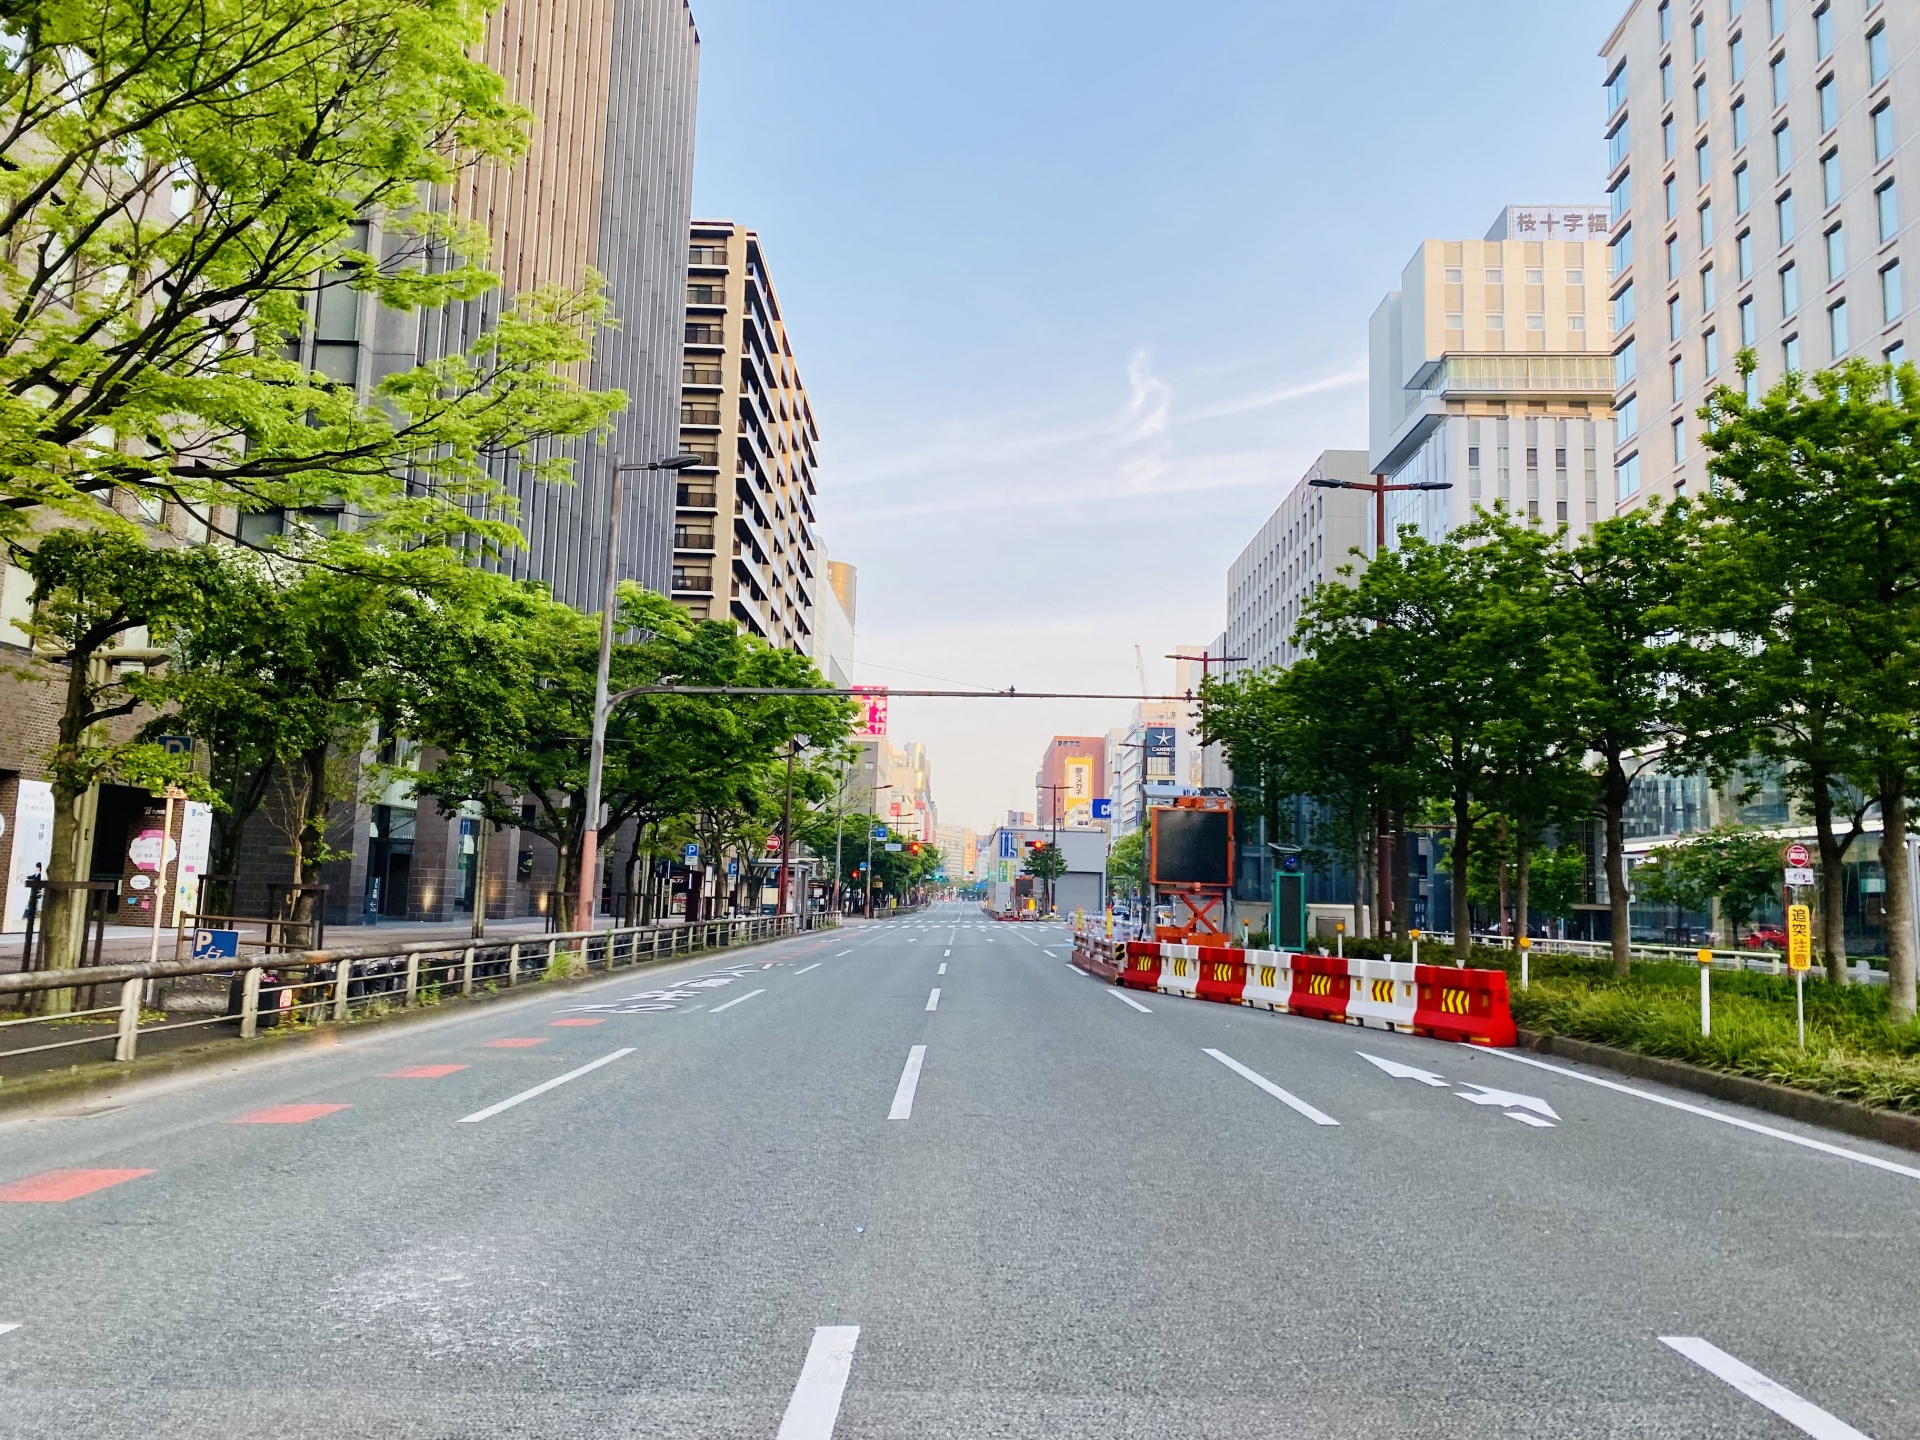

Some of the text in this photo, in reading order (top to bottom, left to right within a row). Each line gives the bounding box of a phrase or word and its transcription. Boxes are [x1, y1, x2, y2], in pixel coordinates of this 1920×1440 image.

[1517, 212, 1608, 233] 桜十字福
[1075, 767, 1083, 795] 夢のメガネ
[689, 845, 696, 855] P
[731, 864, 738, 874] P
[196, 931, 213, 952] P
[1792, 908, 1808, 967] 追突注意
